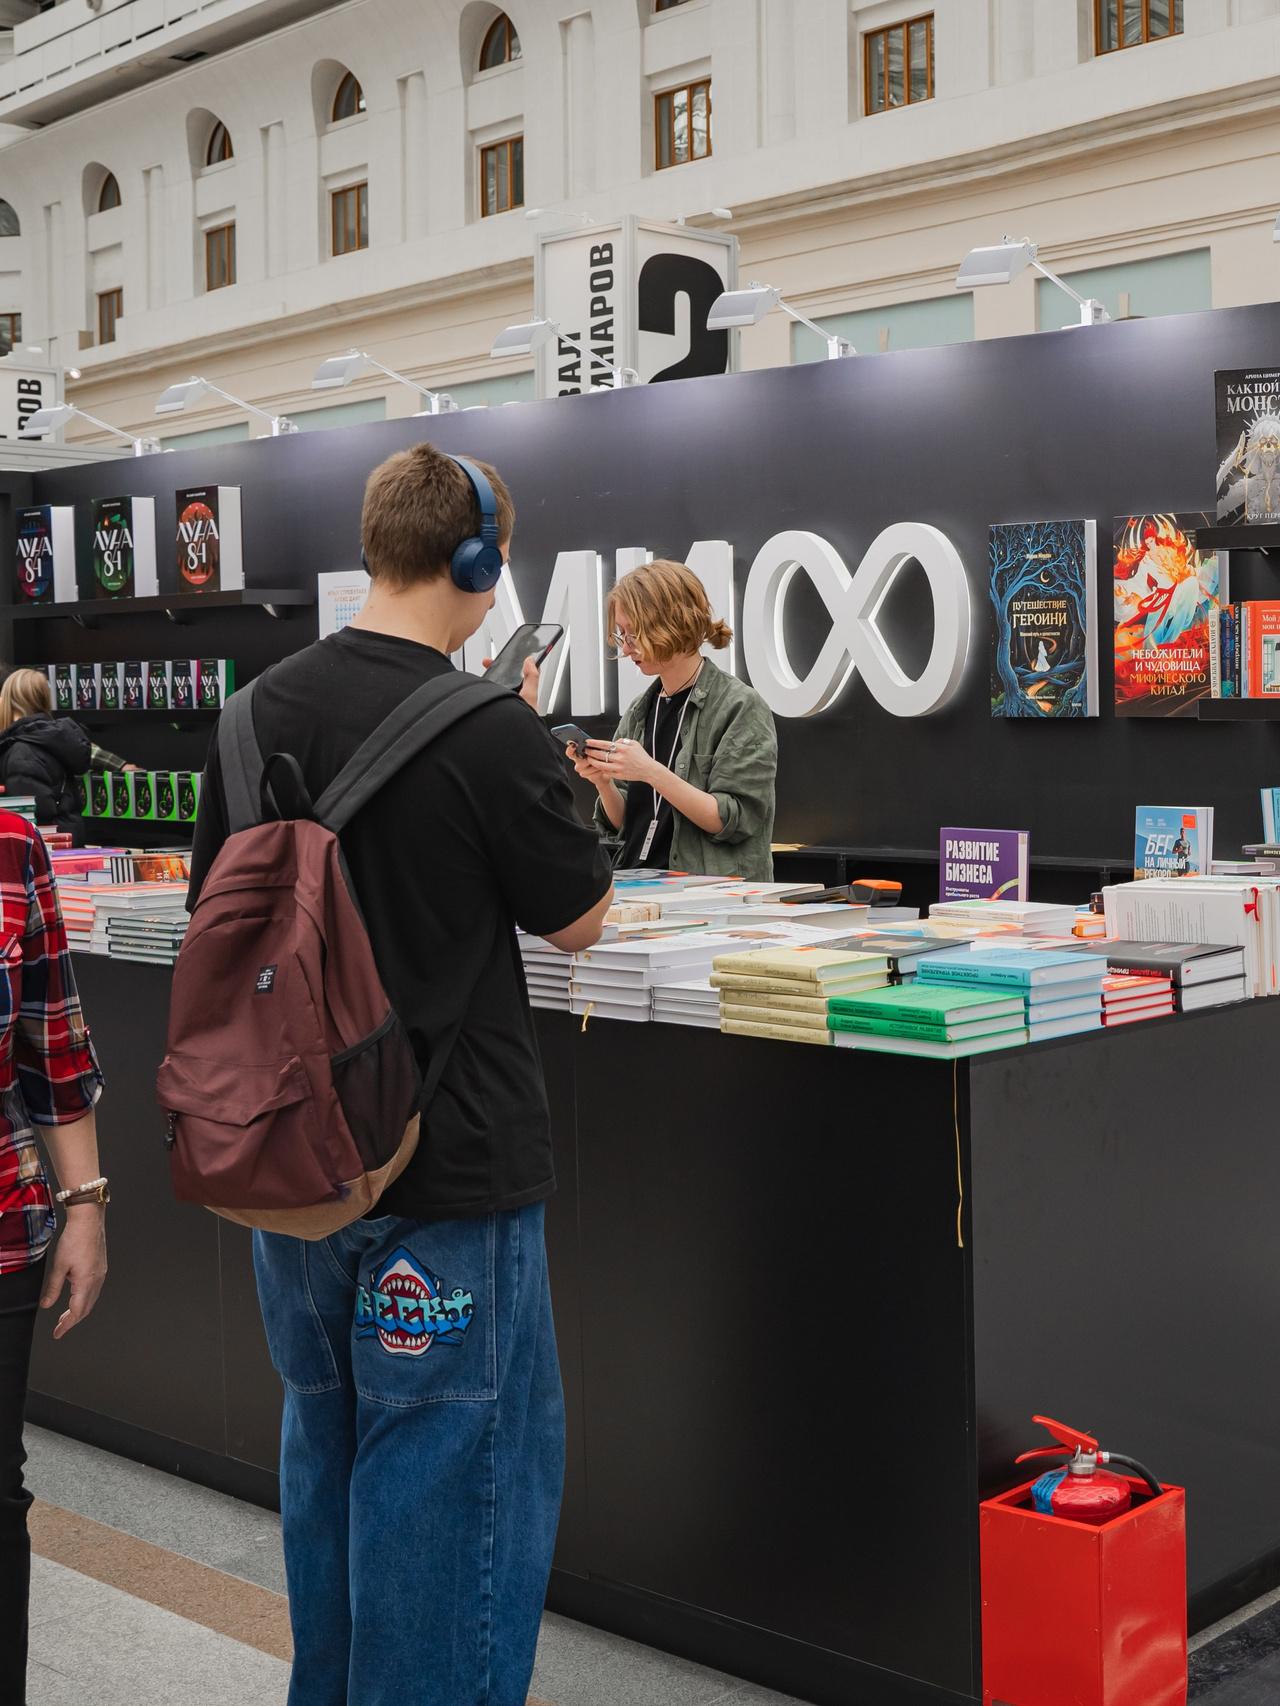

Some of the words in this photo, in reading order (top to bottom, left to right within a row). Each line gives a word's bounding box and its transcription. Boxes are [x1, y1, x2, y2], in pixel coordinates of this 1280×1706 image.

[638, 252, 729, 385] 2
[1227, 383, 1252, 395] КАК
[1012, 599, 1067, 611] ПУТЕШЕСТВИЕ
[1012, 610, 1068, 629] ГЕРОИНИ
[1262, 614, 1276, 622] Мой
[1132, 648, 1203, 660] НЕБОЖИТЕЛИ
[1135, 662, 1143, 671] И
[1145, 660, 1201, 672] ЧУДОВИЩА
[1129, 672, 1207, 684] МИФИЧЕСКОГО
[1150, 685, 1186, 697] КИТАЯ
[945, 839, 1000, 861] РАЗВИТИЕ
[1144, 833, 1174, 856] БЕГ
[1144, 856, 1157, 868] НА
[1156, 856, 1186, 870] ЛИЧНЫЙ
[945, 862, 993, 884] БИЗНЕСА
[920, 968, 951, 976] УПРАВЛЕНИЕ
[951, 970, 979, 979] ПРОЕКТНОЕ
